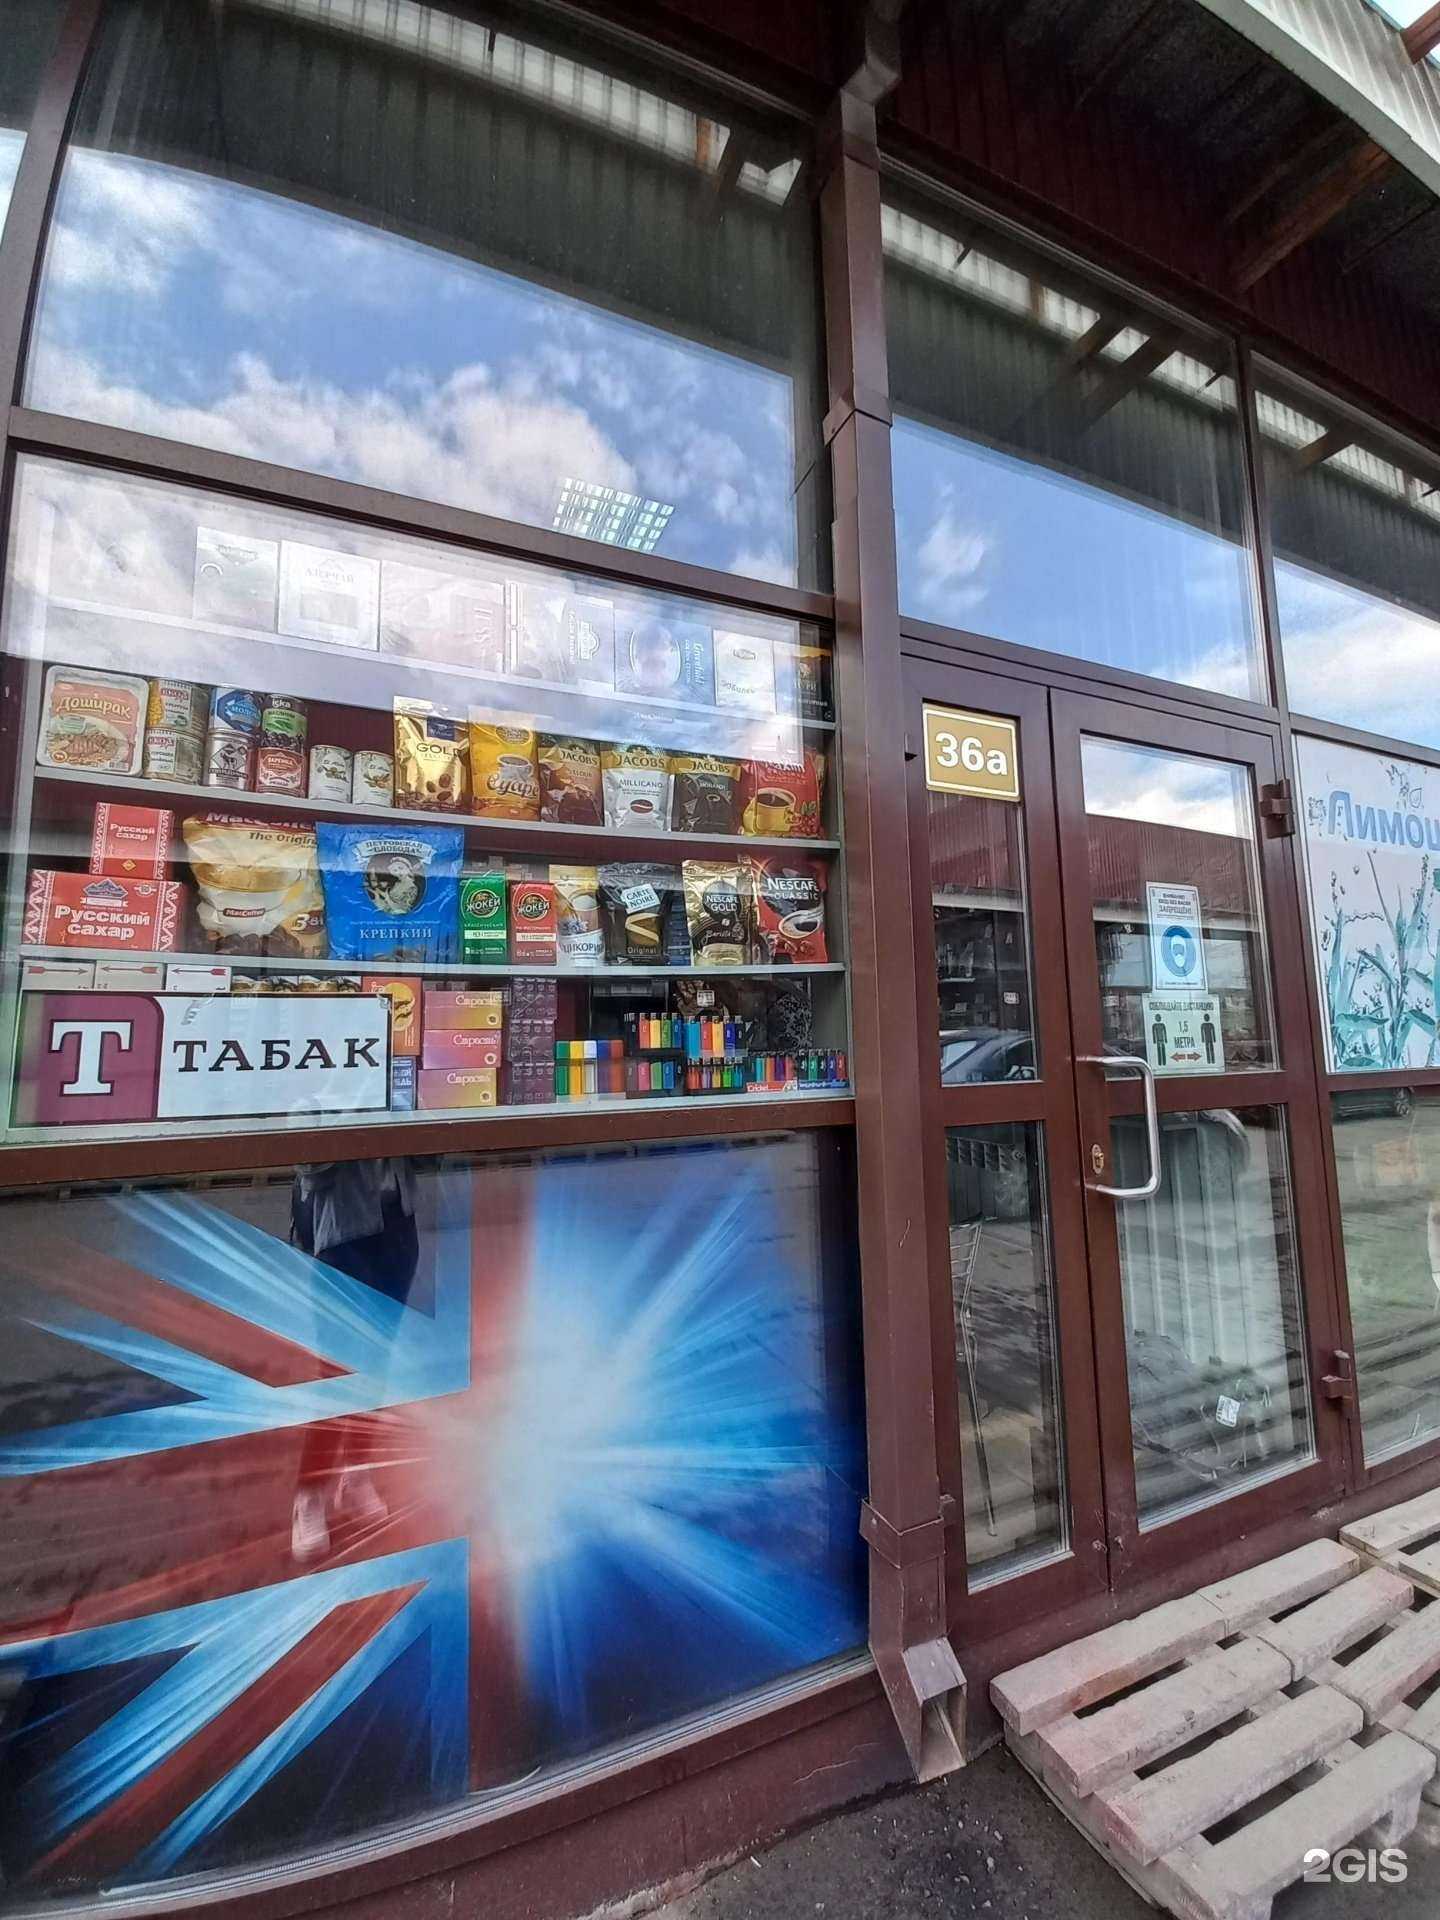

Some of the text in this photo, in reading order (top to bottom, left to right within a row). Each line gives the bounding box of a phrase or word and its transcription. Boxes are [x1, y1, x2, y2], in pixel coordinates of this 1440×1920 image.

[56, 696, 131, 719] Доширак
[560, 751, 598, 766] JACOBS
[934, 732, 1009, 776] 36а
[616, 754, 665, 768] JACOBS
[691, 763, 730, 774] JACOBS
[619, 778, 664, 789] MILLICANO
[110, 823, 156, 835] Русский
[116, 832, 148, 842] сахар
[249, 831, 273, 841] The
[626, 888, 651, 901] CARTE
[774, 891, 819, 901] CLASSIC
[466, 896, 502, 912] ЖОКЕЙ
[517, 900, 551, 914] ЖОКЕЙ
[629, 894, 655, 909] NOIRE
[711, 903, 738, 913] GOLD
[54, 904, 151, 926] Русский
[67, 923, 135, 941] сахар
[359, 926, 432, 939] КРЕПКИЙ
[1174, 1036, 1196, 1049] МЕТРА
[173, 1037, 380, 1073] ТАБАК
